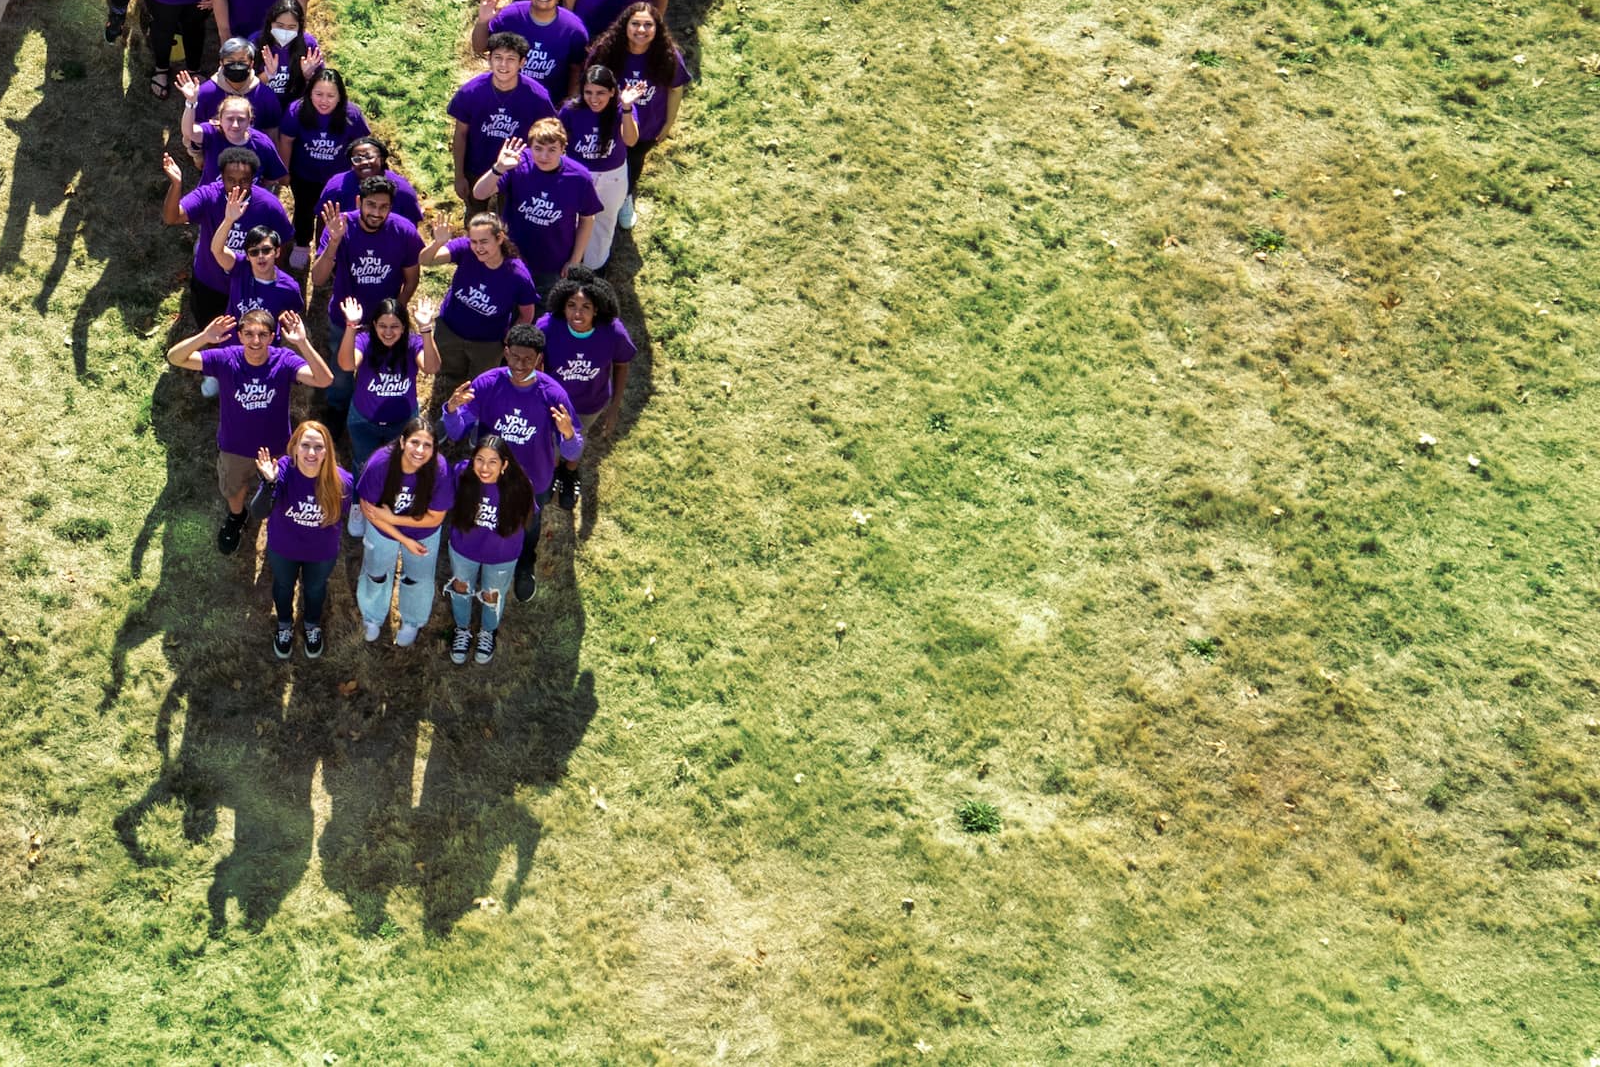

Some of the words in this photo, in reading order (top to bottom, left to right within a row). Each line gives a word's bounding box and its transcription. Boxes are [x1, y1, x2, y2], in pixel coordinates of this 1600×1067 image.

[490, 115, 512, 123] YOU
[481, 120, 519, 134] belong
[312, 139, 334, 148] YOU
[310, 150, 335, 160] HERE
[531, 197, 554, 209] YOU
[518, 201, 563, 223] belong
[524, 214, 551, 227] HERE
[360, 257, 381, 266] YOU
[351, 261, 392, 280] belong
[357, 276, 382, 284] HERE
[469, 289, 491, 303] YOU
[455, 289, 497, 316] belong
[568, 360, 592, 368] YOU
[379, 373, 401, 382] YOU
[557, 365, 601, 378] belong
[563, 373, 589, 381] HERE
[244, 383, 267, 393] YOU
[368, 380, 411, 393] belong
[235, 388, 276, 404] belong
[504, 414, 527, 427] YOU
[494, 419, 537, 442] belong
[500, 433, 525, 445] HERE
[298, 501, 321, 512] YOU
